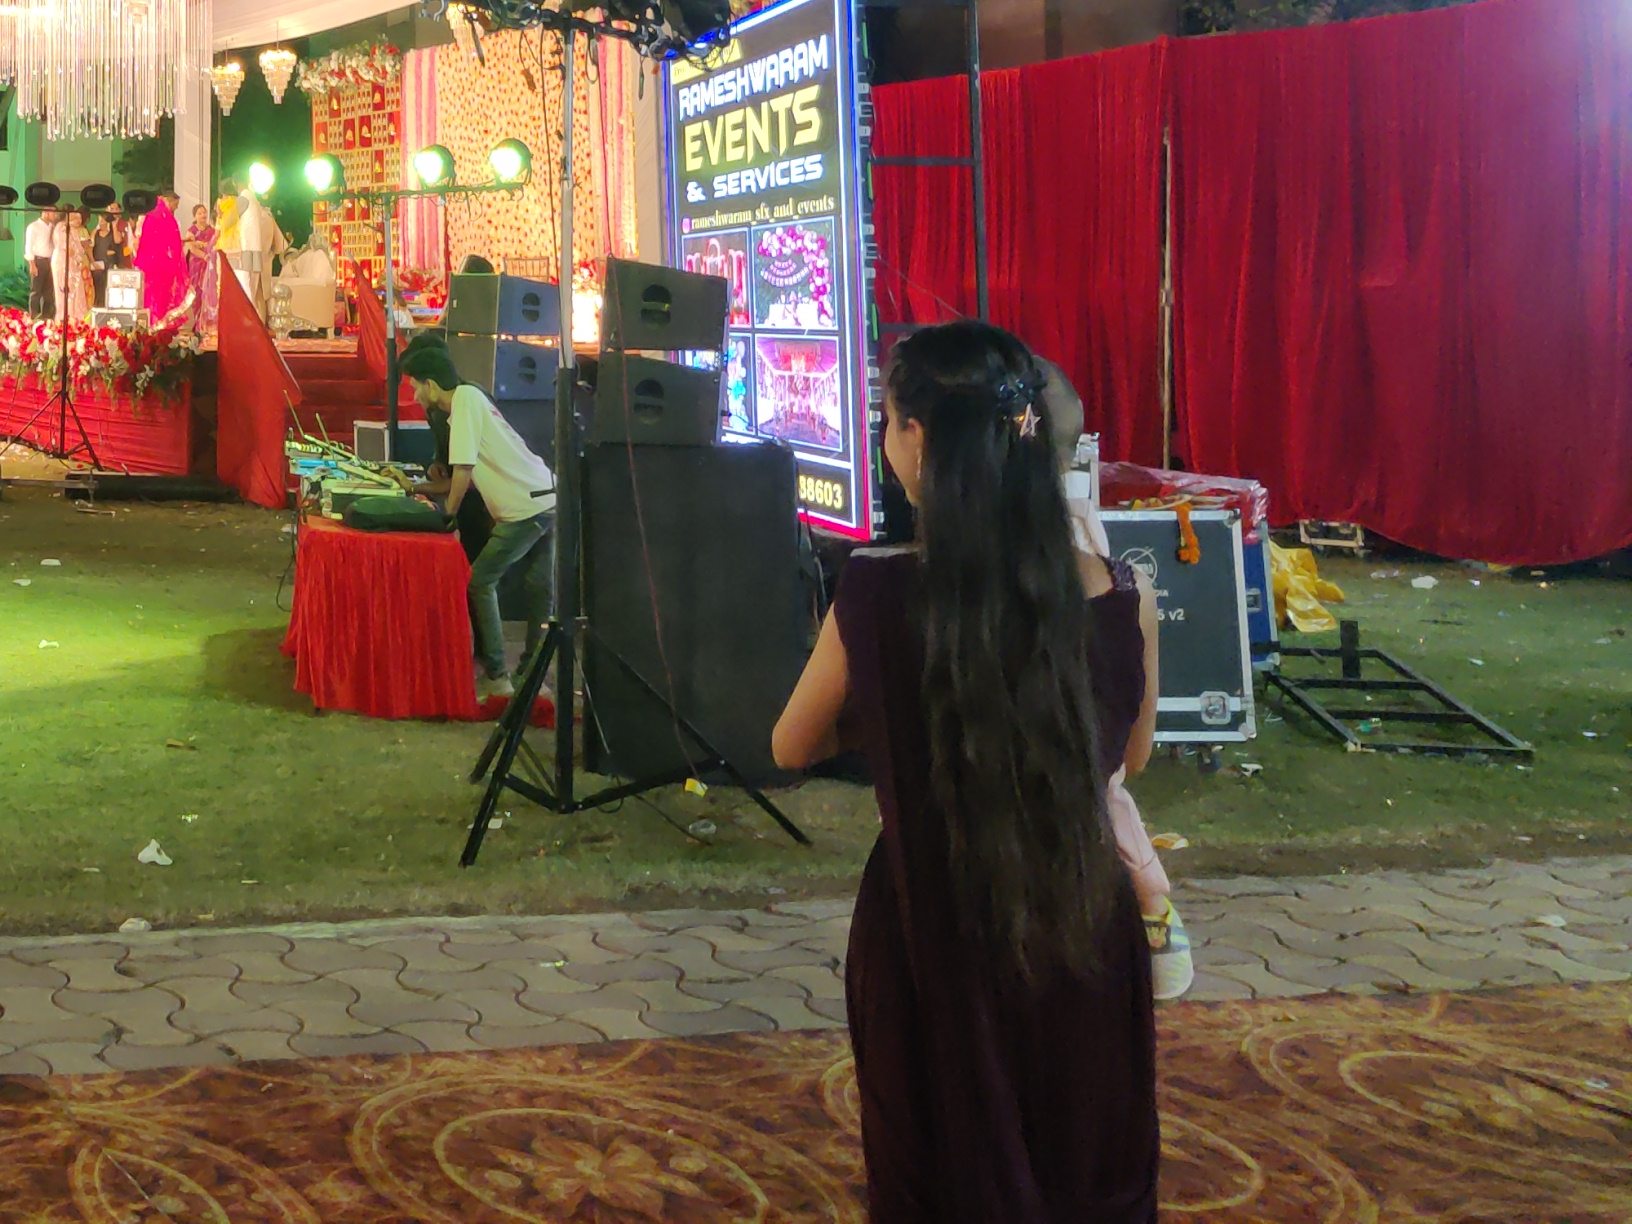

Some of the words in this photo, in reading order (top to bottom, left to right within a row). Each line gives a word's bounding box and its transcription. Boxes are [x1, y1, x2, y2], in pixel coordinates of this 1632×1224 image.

[679, 34, 830, 121] RAMESHWARAM
[685, 84, 822, 172] EVENTS
[686, 180, 707, 203] &
[713, 153, 824, 199] SERVICES
